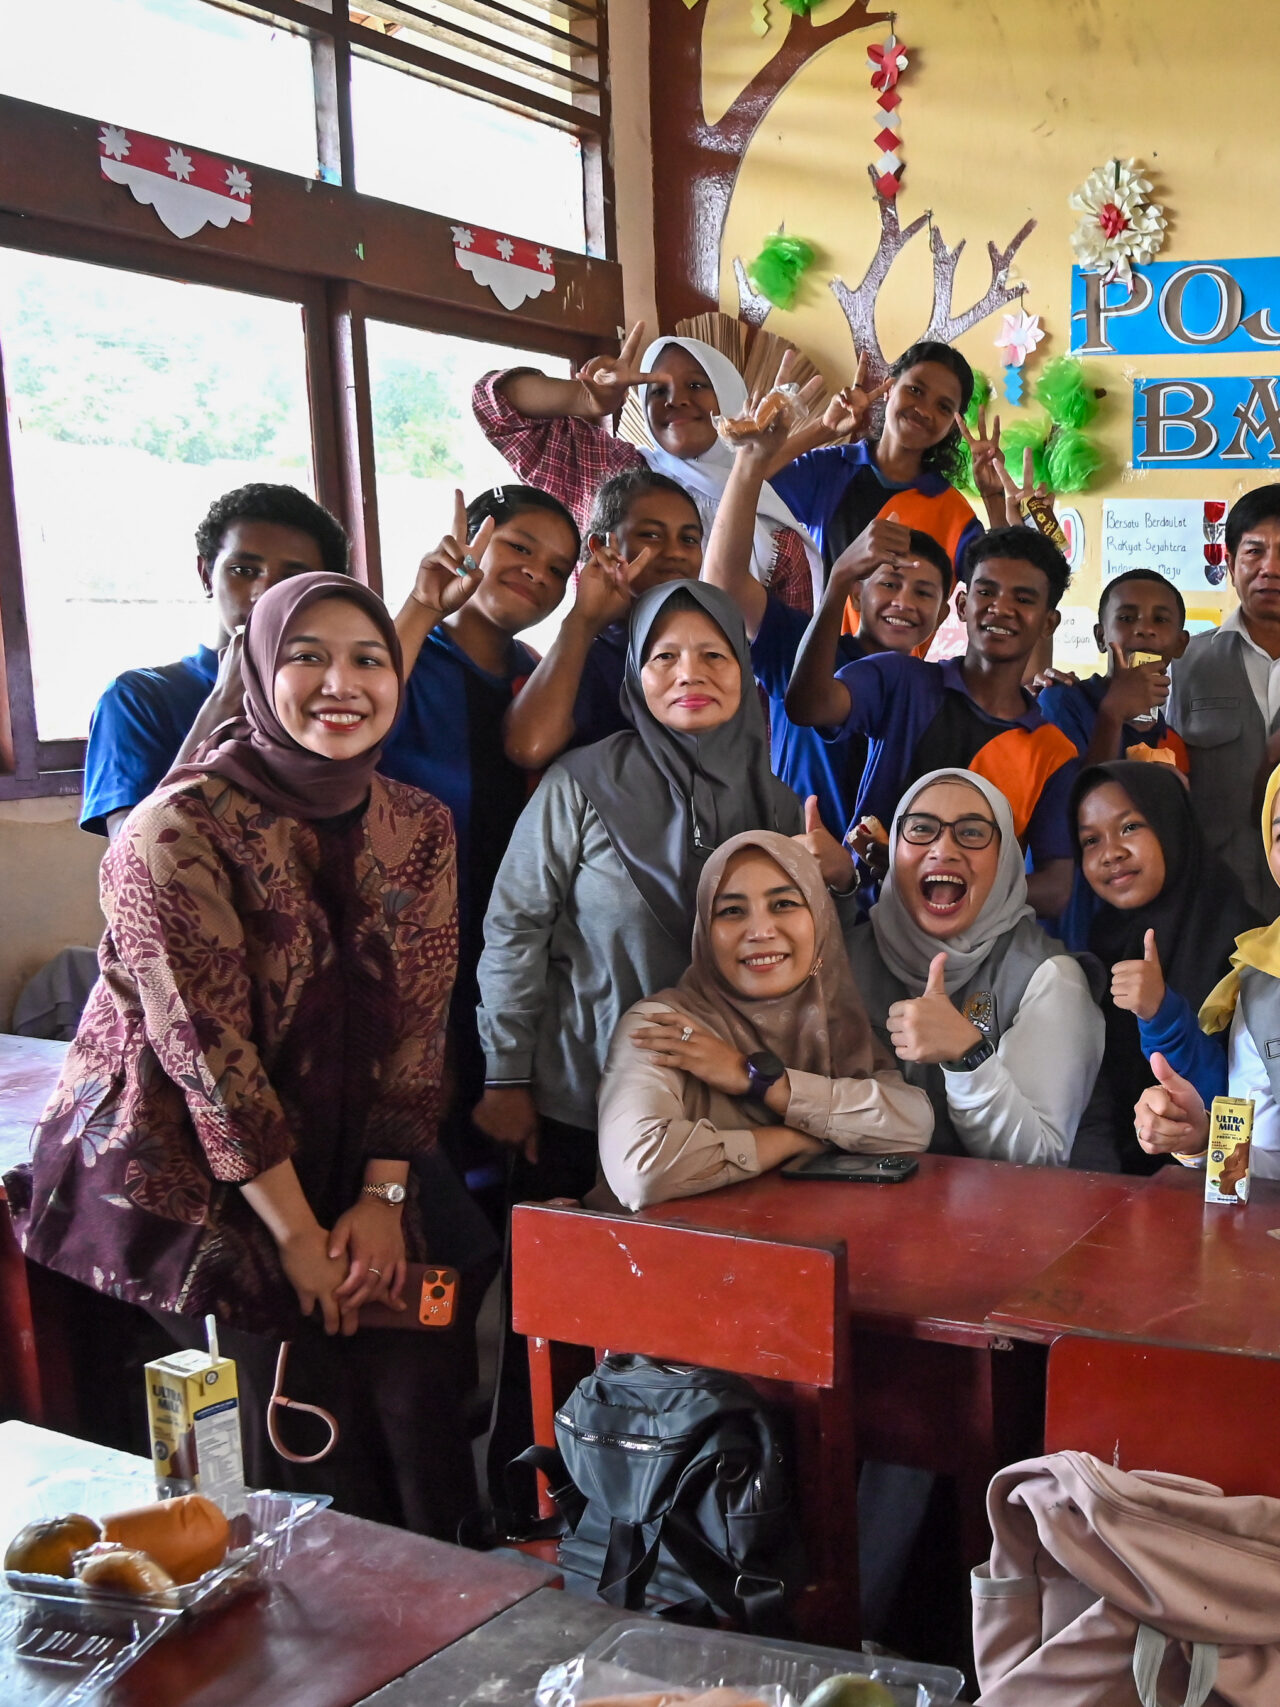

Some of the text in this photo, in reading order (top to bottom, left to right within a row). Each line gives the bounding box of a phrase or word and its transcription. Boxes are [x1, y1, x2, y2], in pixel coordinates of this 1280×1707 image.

[1106, 511, 1187, 529] Bersatu Berdaulat
[1145, 538, 1187, 555] Sejahtera
[1162, 563, 1181, 579] Maju
[1215, 1115, 1245, 1125] ULTRA
[1219, 1123, 1241, 1131] MILK
[152, 1384, 182, 1404] ULTRA
